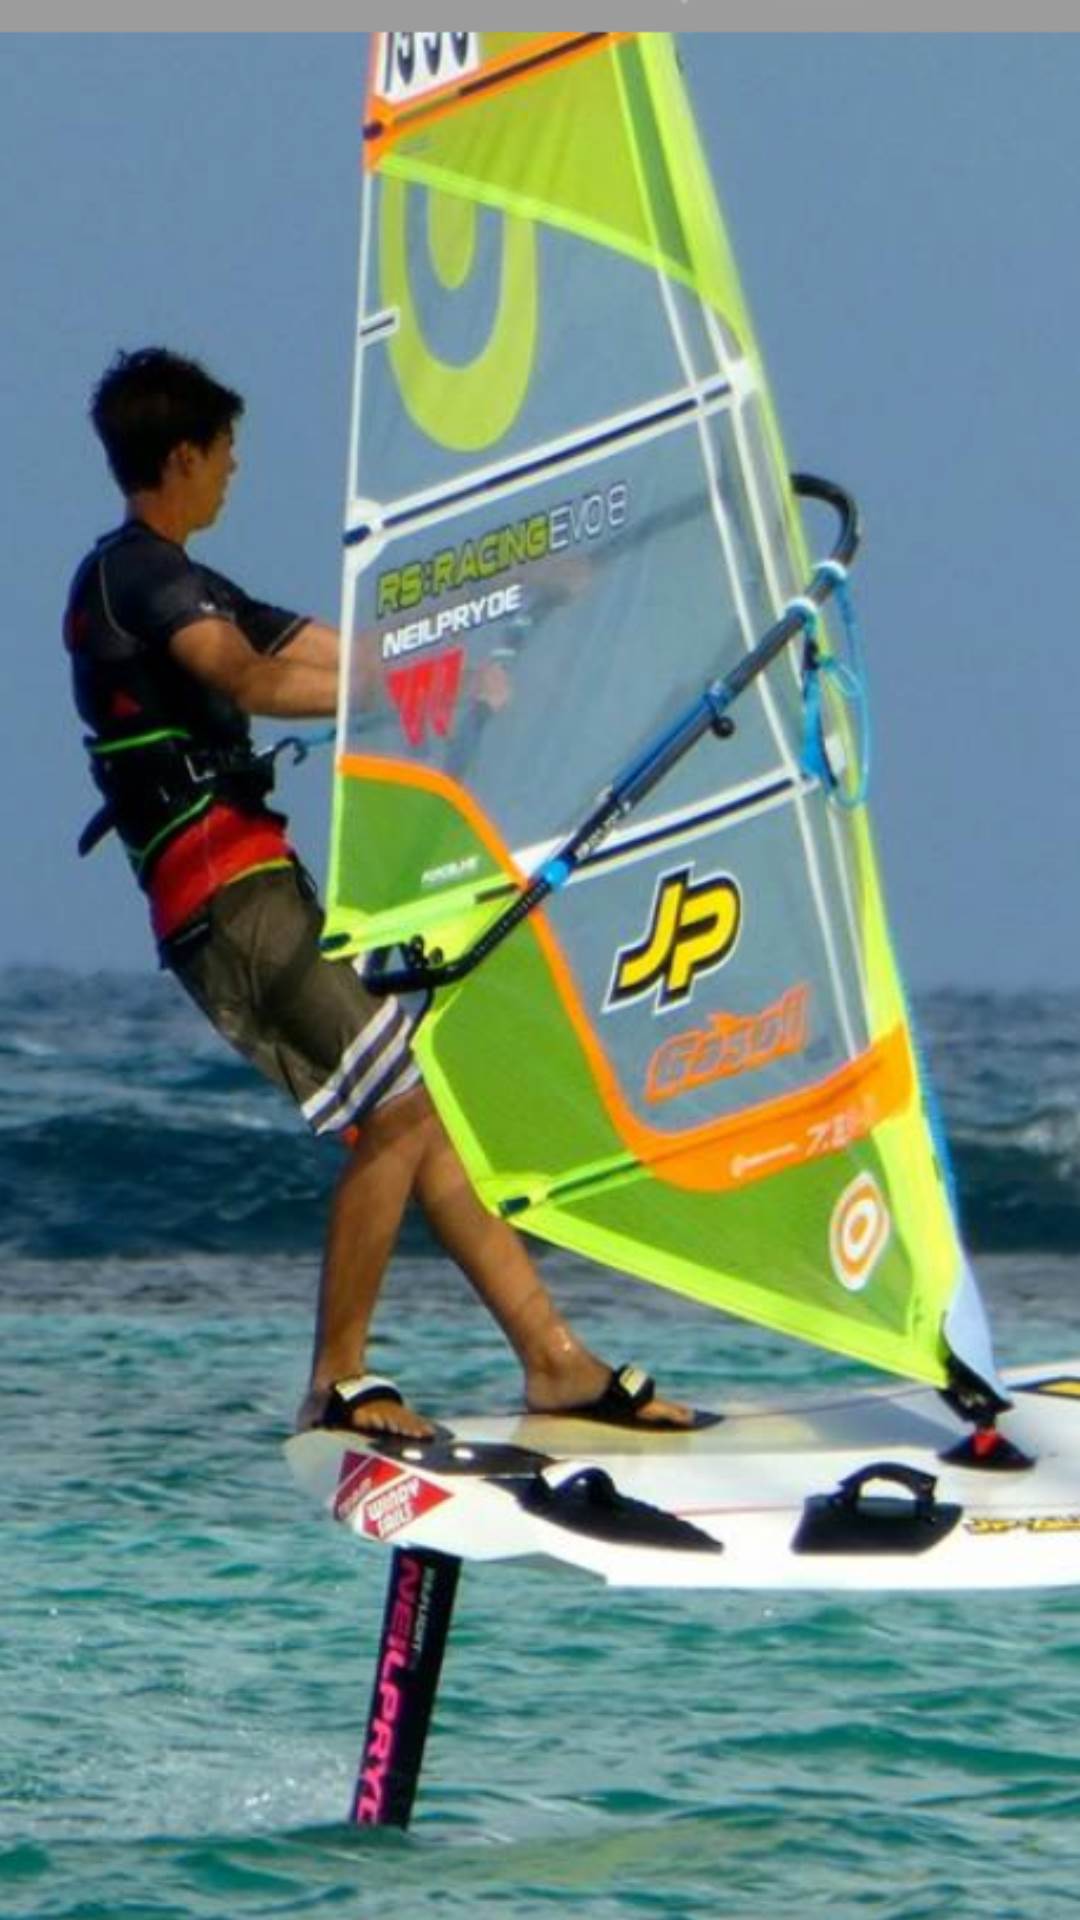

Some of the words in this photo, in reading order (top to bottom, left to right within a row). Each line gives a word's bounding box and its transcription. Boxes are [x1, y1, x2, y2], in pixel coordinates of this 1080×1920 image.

[382, 584, 523, 659] NEILPRYDE
[602, 861, 741, 1014] JP
[356, 1556, 422, 1826] NEILPRYD
